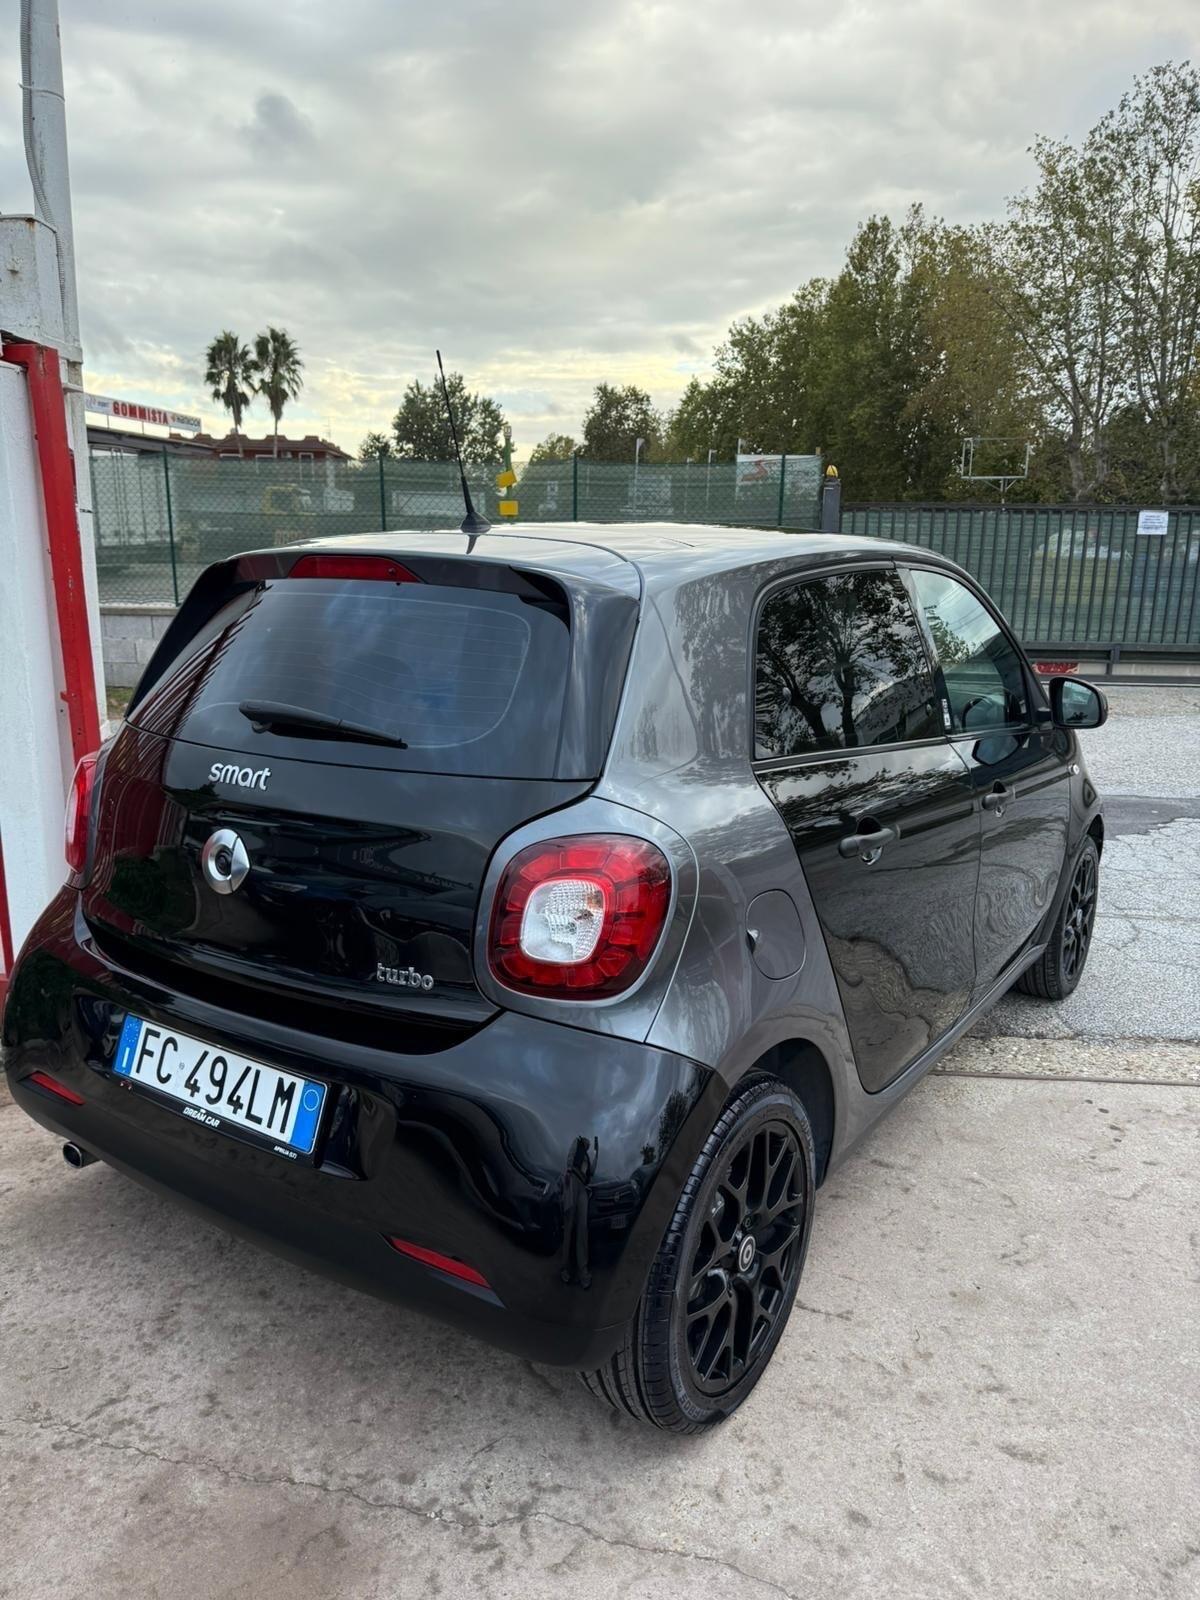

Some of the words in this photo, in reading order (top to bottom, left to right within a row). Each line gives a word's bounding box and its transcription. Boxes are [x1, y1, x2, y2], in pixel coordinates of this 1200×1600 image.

[112, 401, 169, 425] GOMMISTA
[208, 762, 271, 791] smart
[376, 962, 435, 991] turbo
[136, 1027, 178, 1084] FC
[182, 1106, 207, 1122] DREAM
[204, 1116, 220, 1128] CAR
